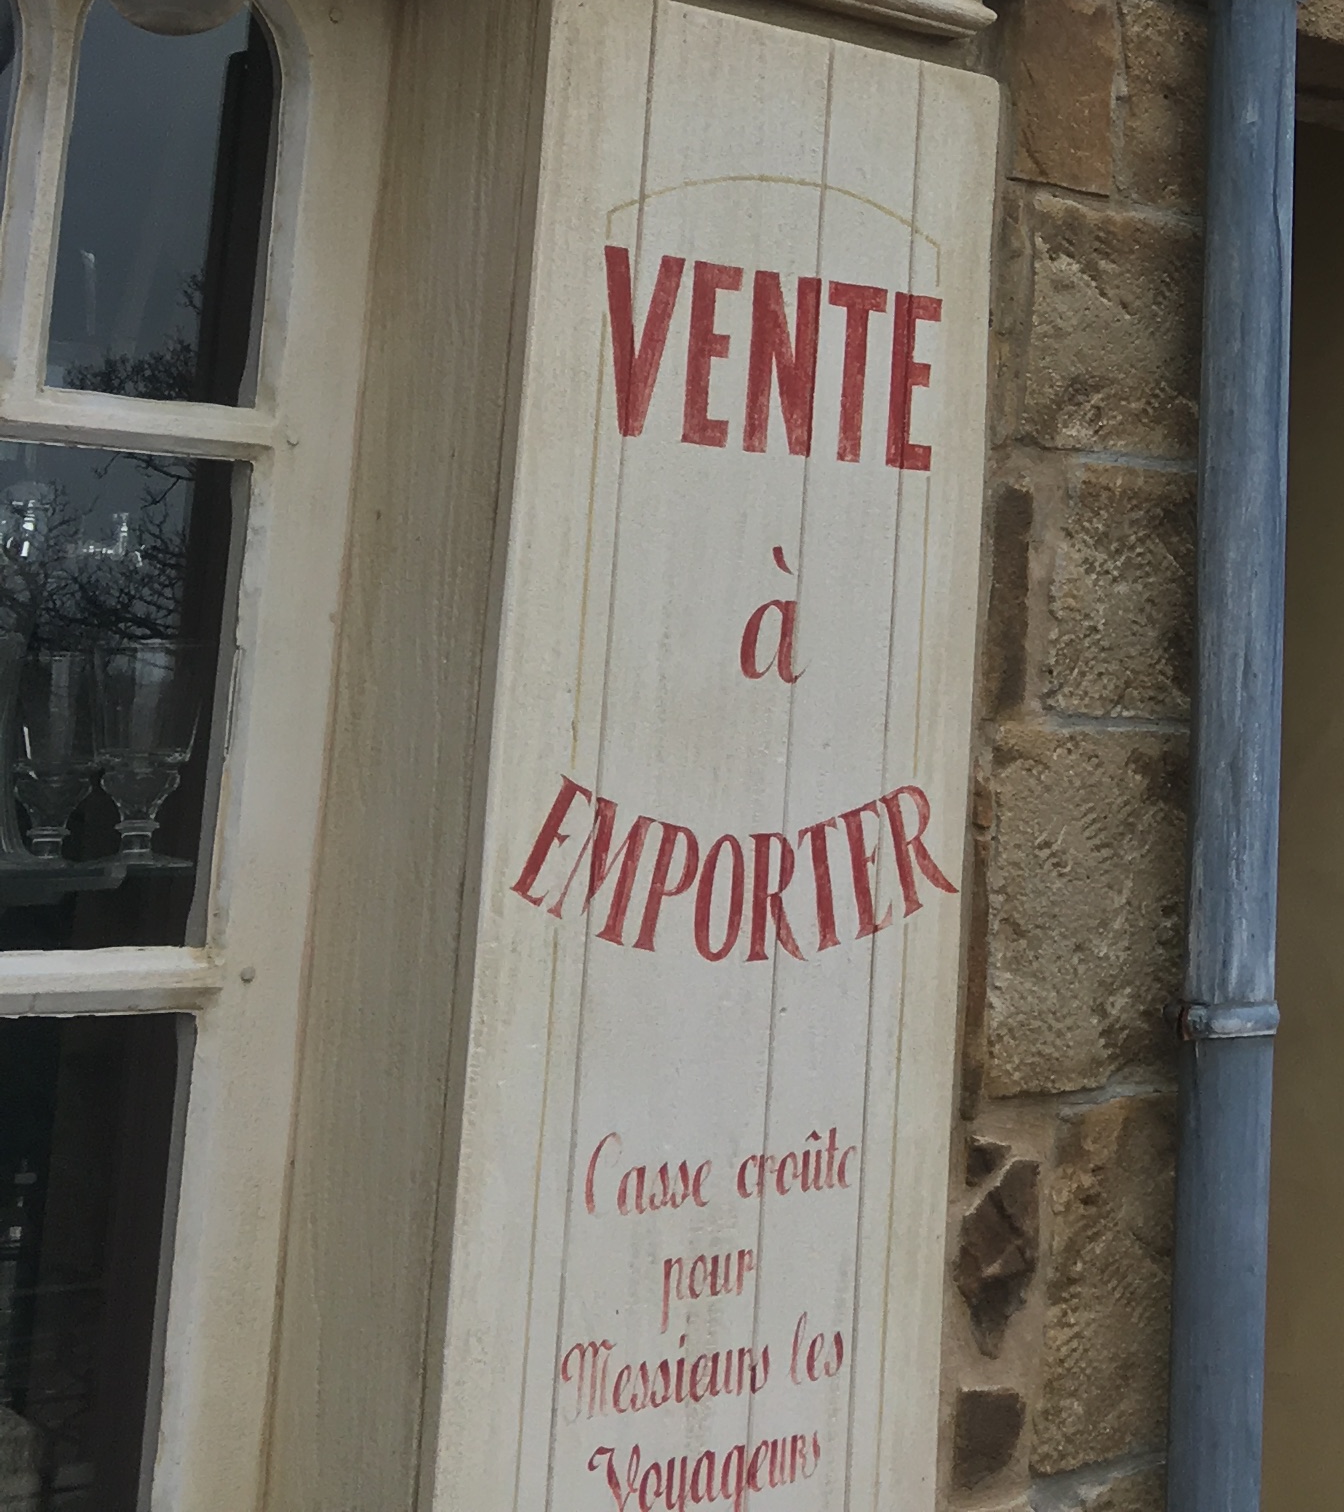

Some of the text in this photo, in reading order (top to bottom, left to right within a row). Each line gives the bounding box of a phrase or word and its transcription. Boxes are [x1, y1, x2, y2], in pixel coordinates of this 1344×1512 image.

[603, 245, 944, 473] VENTE
[740, 546, 806, 684] à
[512, 772, 960, 963] EMPORTER
[584, 1131, 713, 1216] Casse
[660, 1248, 755, 1335] pour
[789, 1311, 845, 1386] les
